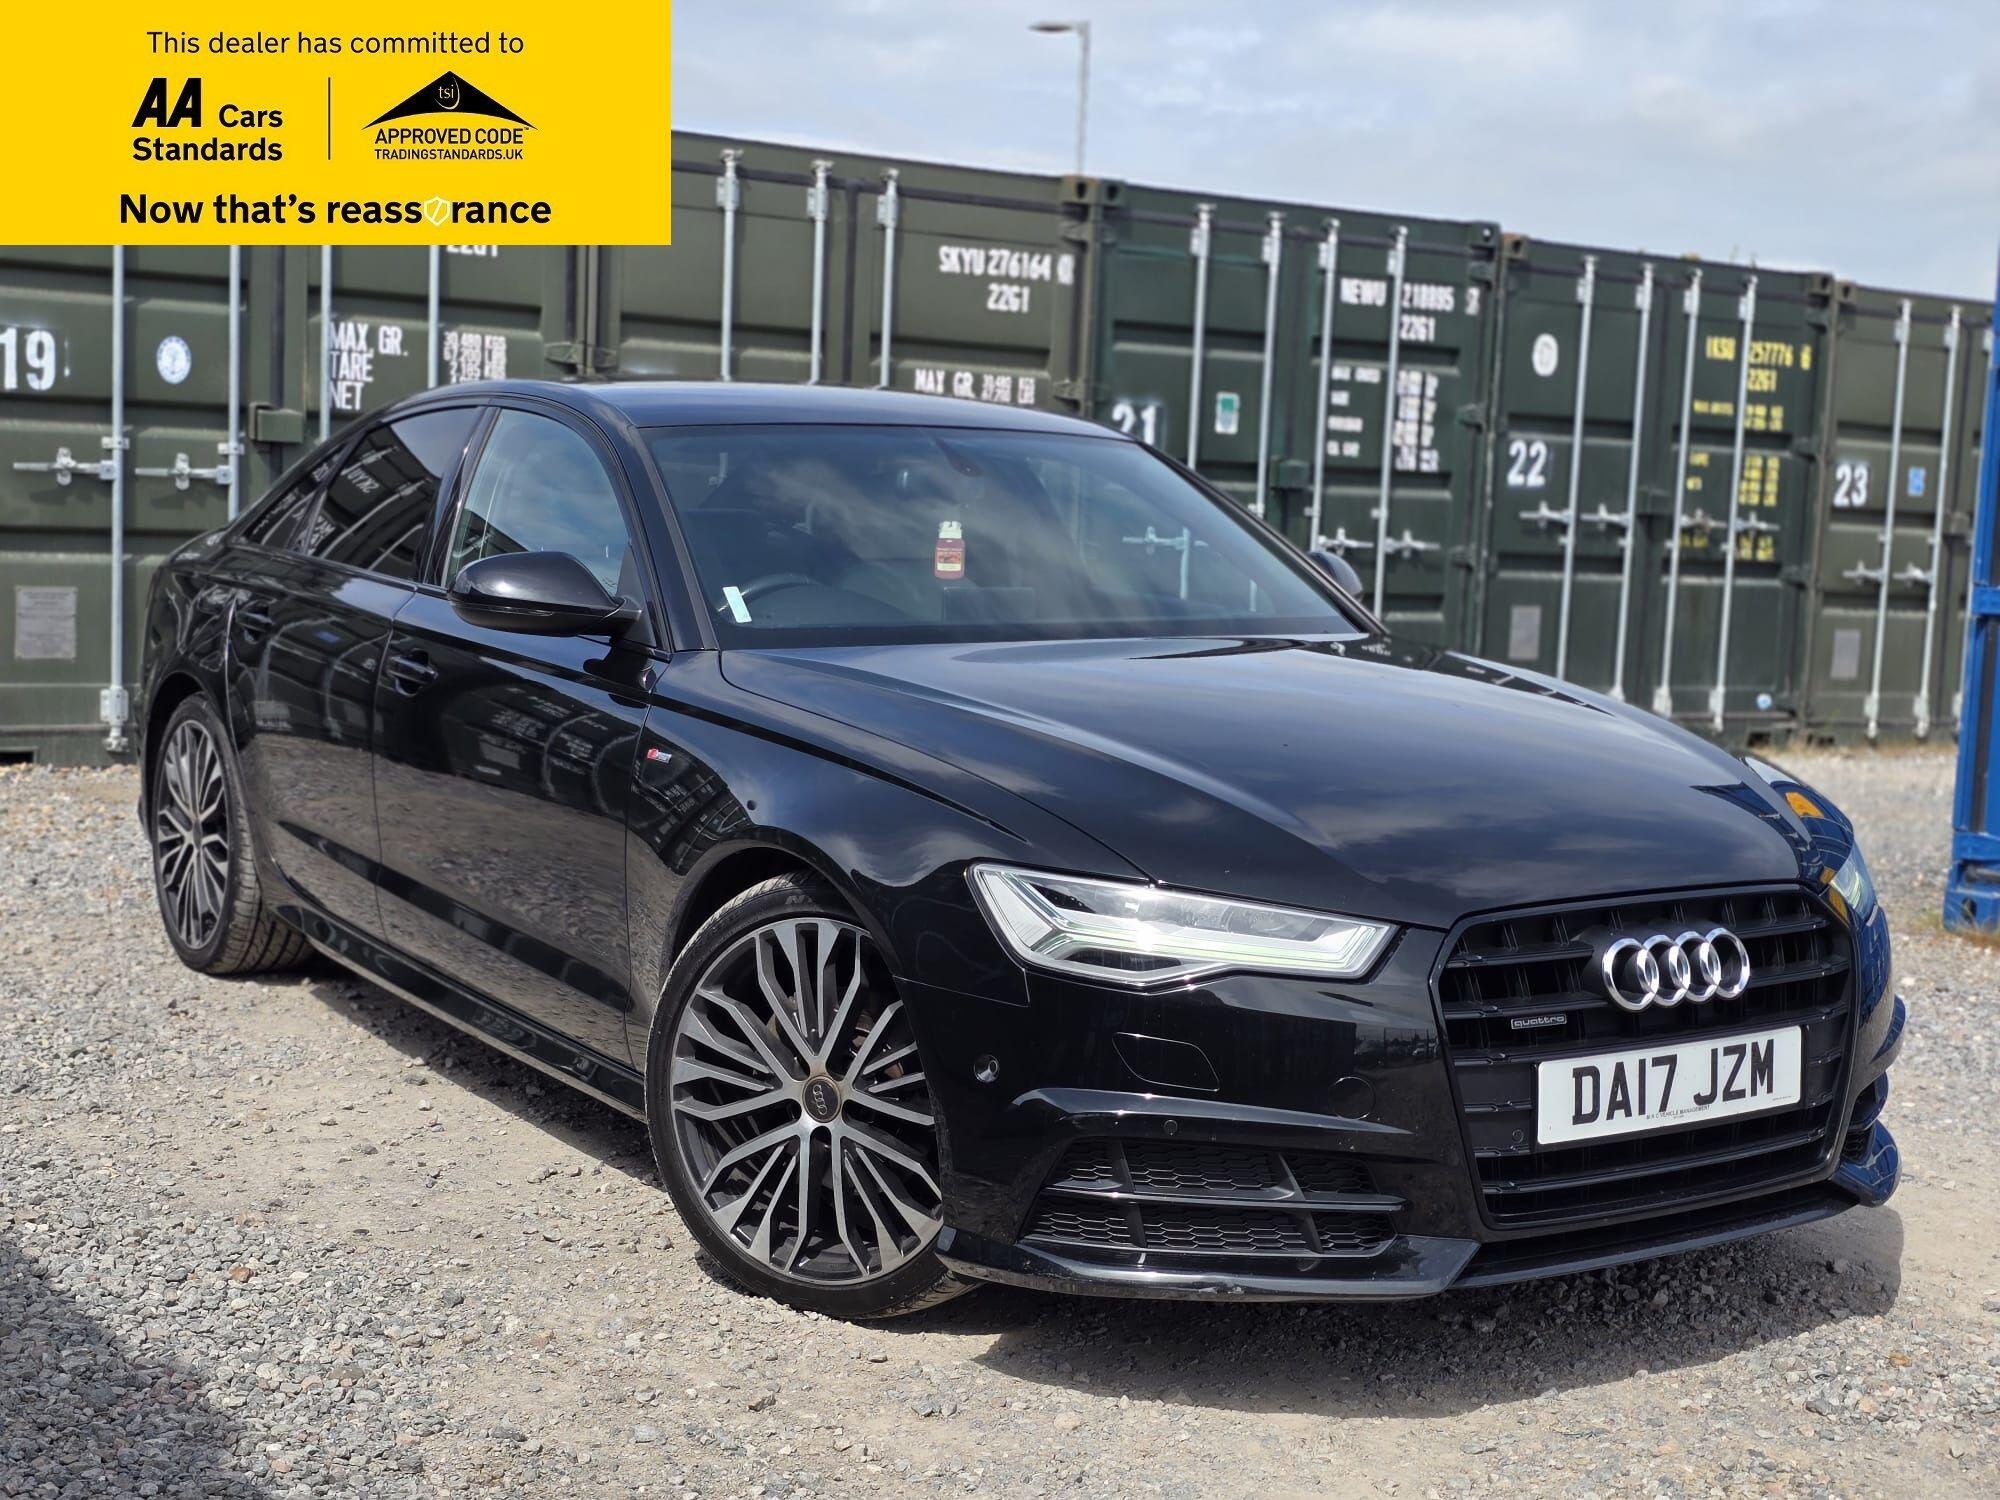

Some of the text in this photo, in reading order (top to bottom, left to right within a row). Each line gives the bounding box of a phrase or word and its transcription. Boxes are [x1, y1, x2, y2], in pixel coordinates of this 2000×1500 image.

[938, 245, 985, 276] SKYU
[987, 248, 1052, 281] 276164
[0, 327, 56, 391] 19
[1112, 402, 1157, 445] 21
[1507, 439, 1548, 487] 22
[1833, 463, 1868, 507] 23
[1514, 1016, 1564, 1027] quattro
[1572, 1039, 1775, 1125] DA17 JZM
